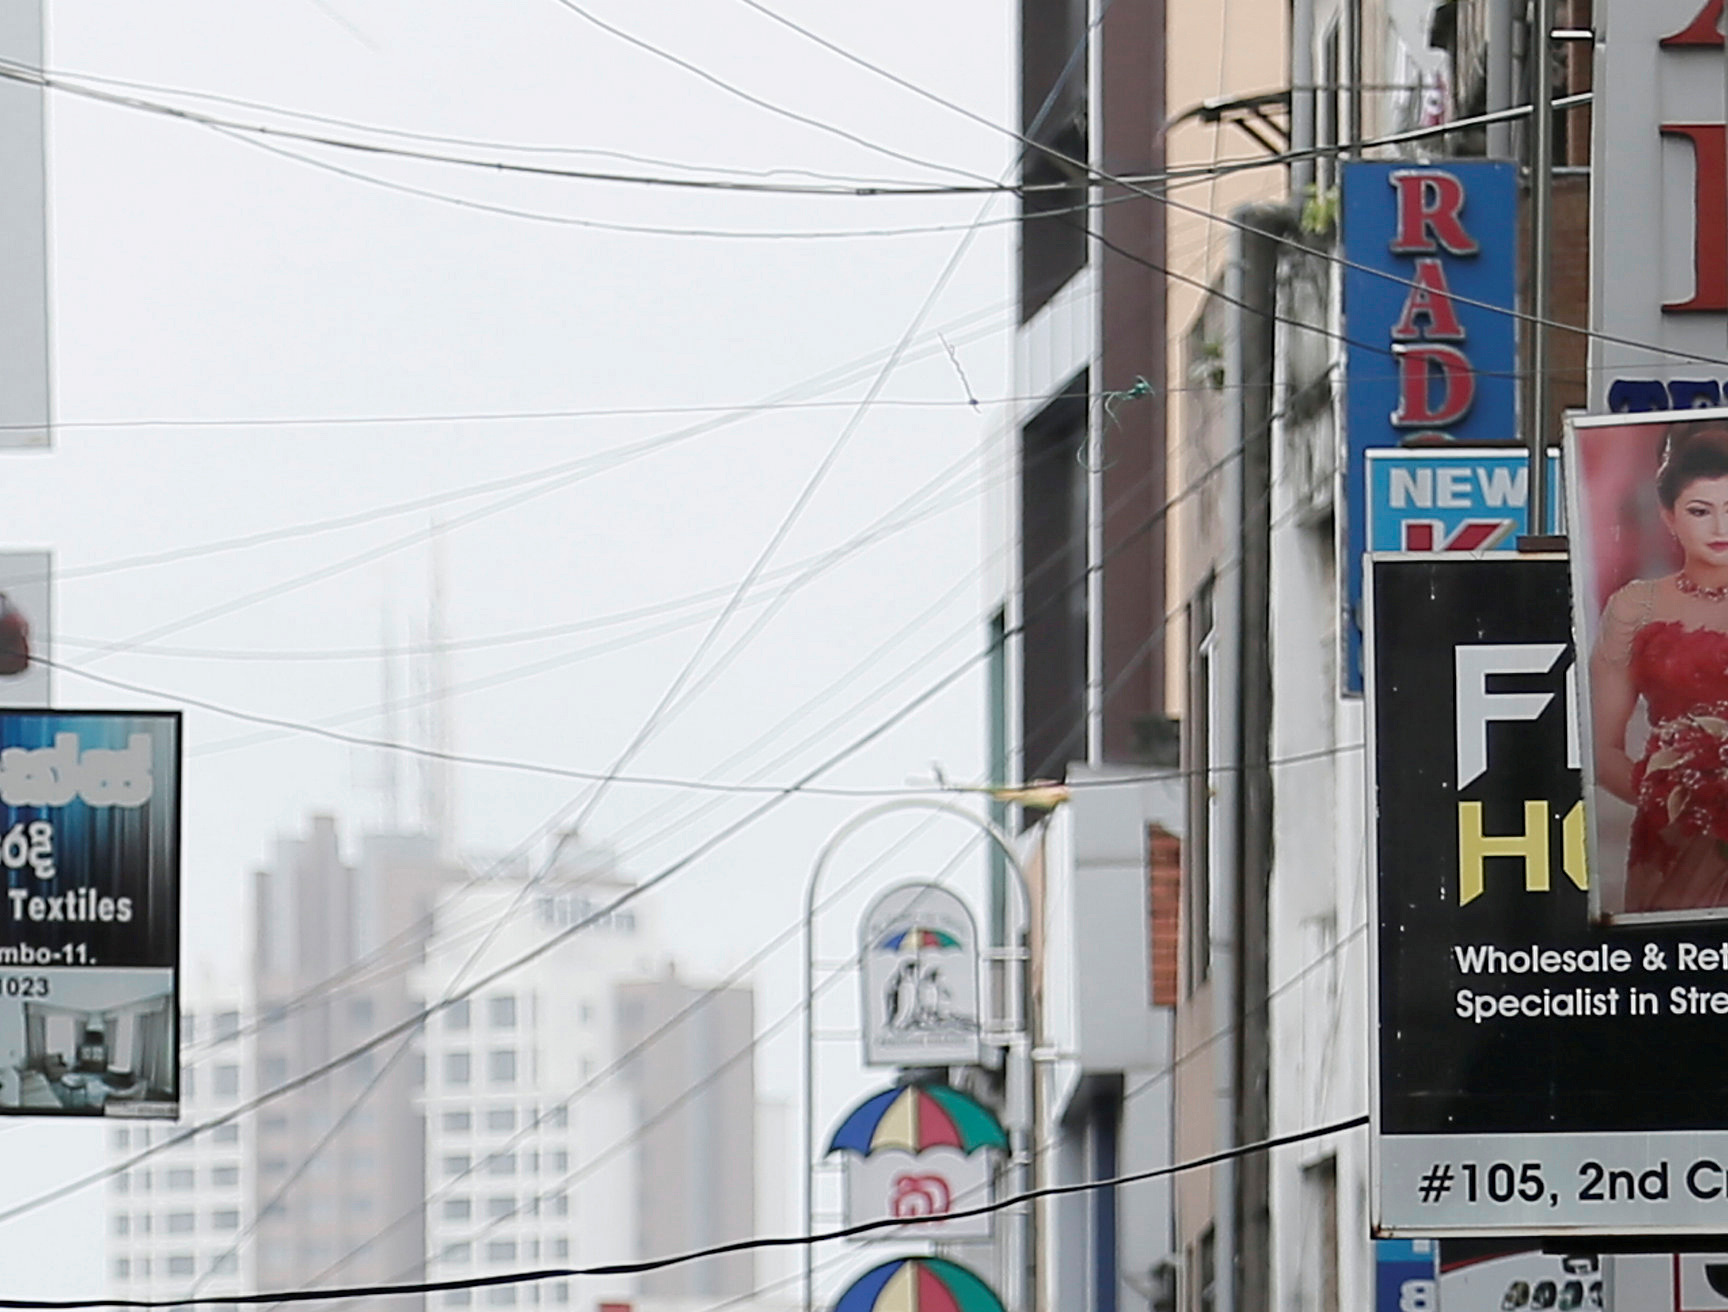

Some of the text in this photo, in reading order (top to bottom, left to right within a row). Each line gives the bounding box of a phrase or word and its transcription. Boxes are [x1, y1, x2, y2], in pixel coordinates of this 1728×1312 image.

[1389, 169, 1477, 445] RAD
[1389, 467, 1529, 508] NEW
[8, 888, 133, 922] Textiles
[1455, 942, 1632, 974] Wholesale
[1642, 944, 1666, 971] &
[1455, 987, 1619, 1022] Specialist
[1629, 988, 1659, 1014] in
[1418, 1162, 1559, 1208] #105,
[1578, 1161, 1669, 1203] 2nd
